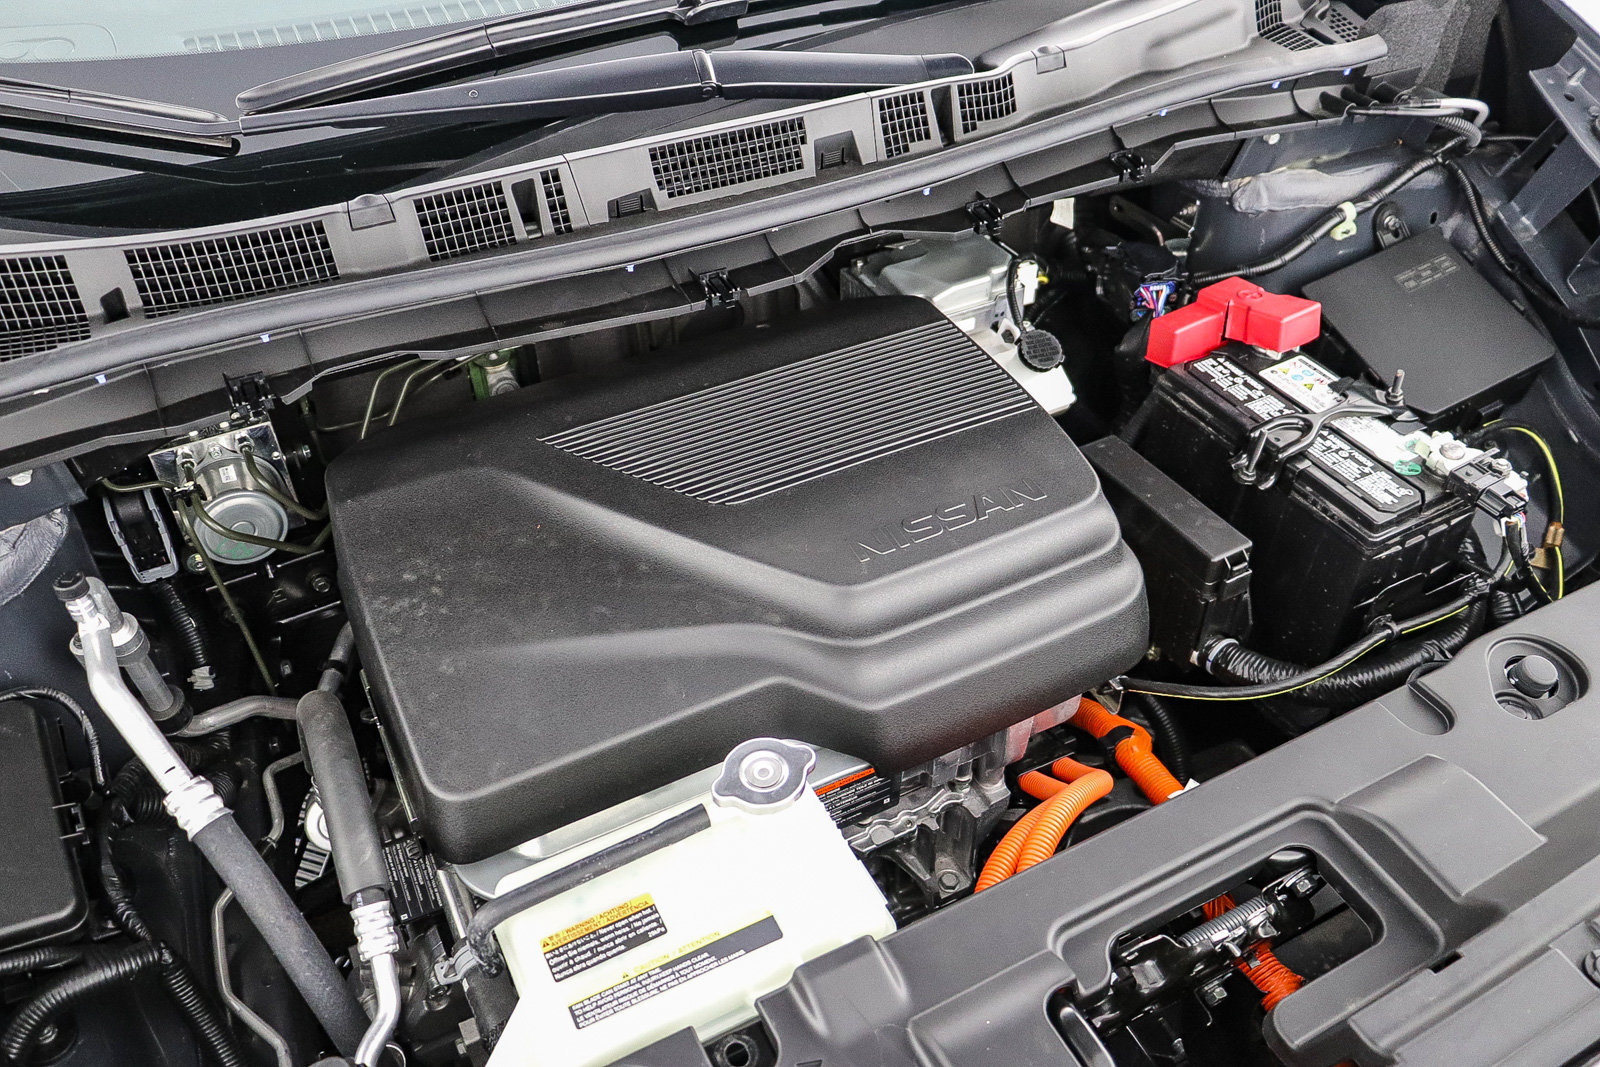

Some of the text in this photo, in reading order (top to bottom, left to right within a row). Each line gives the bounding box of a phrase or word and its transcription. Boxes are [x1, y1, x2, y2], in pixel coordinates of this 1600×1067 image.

[849, 478, 1048, 563] NISSAN
[566, 918, 595, 934] WARNING
[599, 903, 629, 919] ACHTUNG
